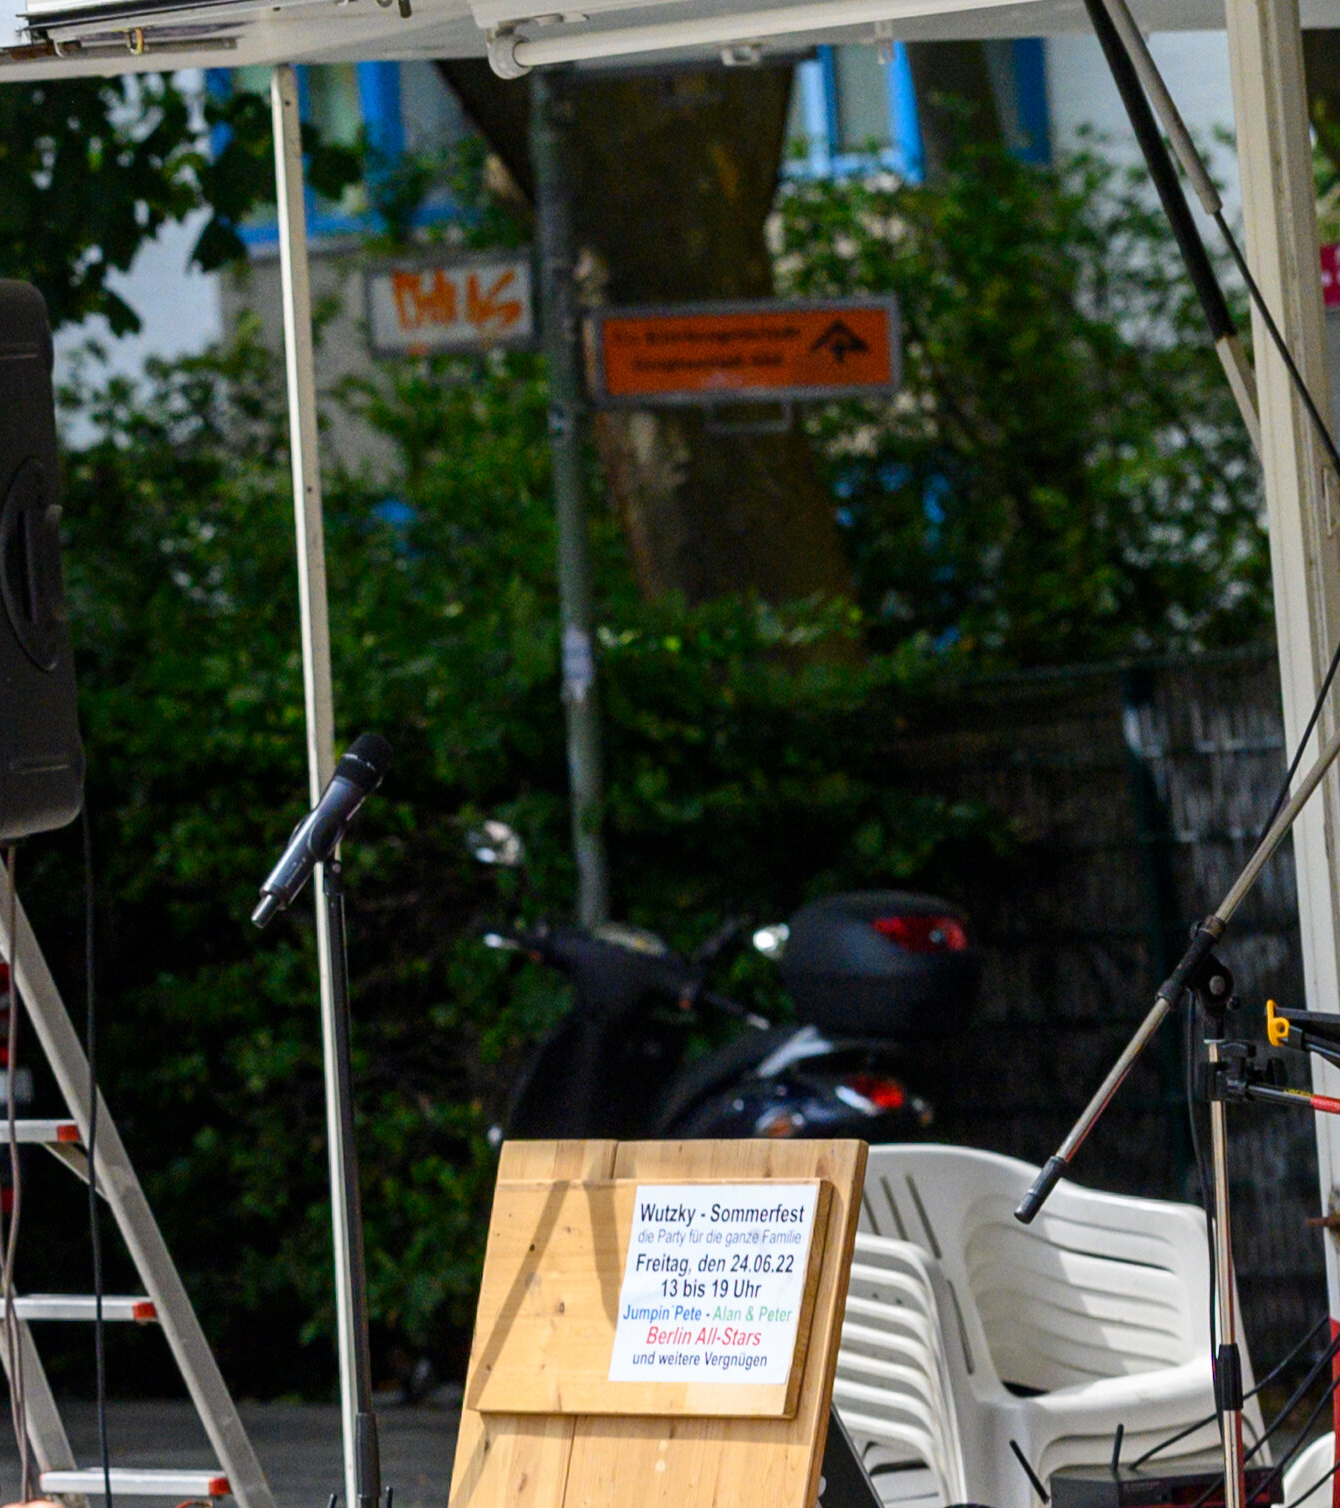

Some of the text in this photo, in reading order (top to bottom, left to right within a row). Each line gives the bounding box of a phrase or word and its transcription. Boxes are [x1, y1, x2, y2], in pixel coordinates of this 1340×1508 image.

[641, 1203, 696, 1228] Wutzky
[710, 1203, 805, 1223] Sommerfest
[638, 1228, 802, 1248] die Party für die ganze Familie
[636, 1253, 794, 1277] Freitag, den 24.06.22
[661, 1278, 762, 1298] 13 bis 19 Uhr
[712, 1305, 741, 1321] Alan
[745, 1305, 754, 1322] &
[758, 1305, 793, 1322] Peter
[646, 1325, 762, 1346] Berlin All-Stars
[632, 1350, 768, 1371] und weitere Vergnügen
